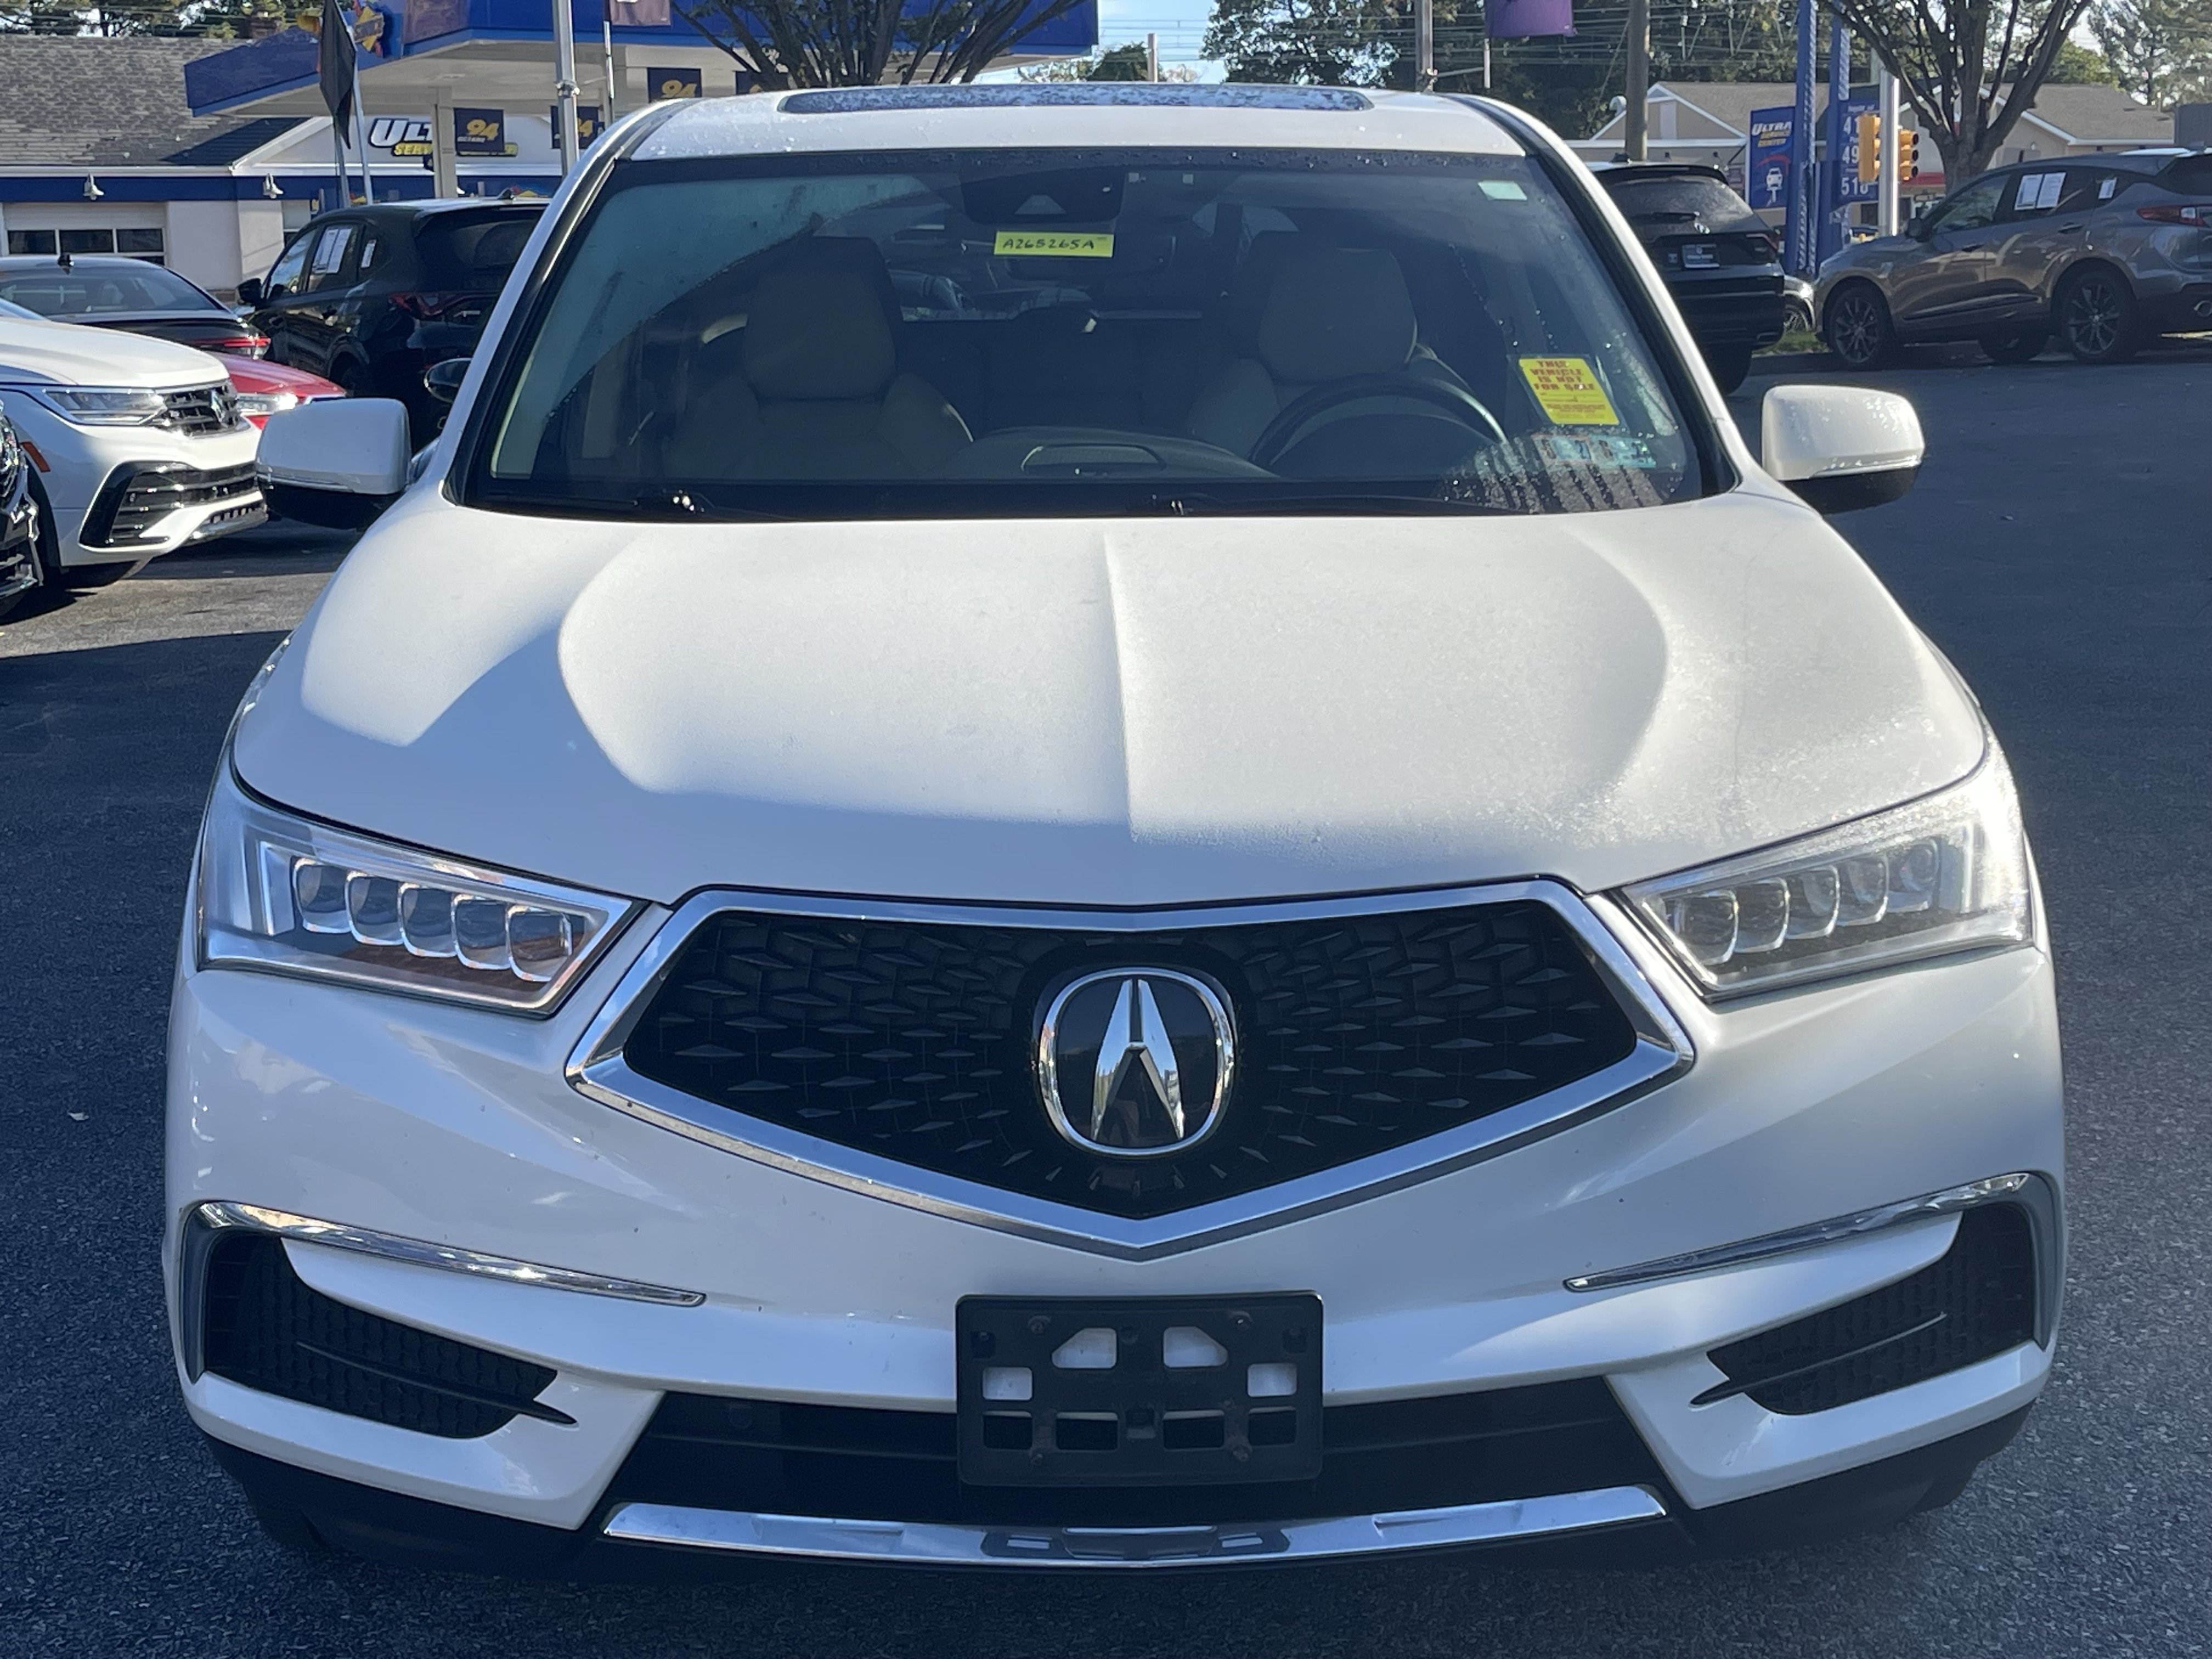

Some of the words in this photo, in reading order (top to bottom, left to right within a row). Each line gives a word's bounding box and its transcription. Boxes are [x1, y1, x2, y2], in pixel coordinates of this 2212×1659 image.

[370, 119, 432, 147] ULT
[467, 119, 499, 140] 94
[1752, 121, 1792, 136] ULTRA
